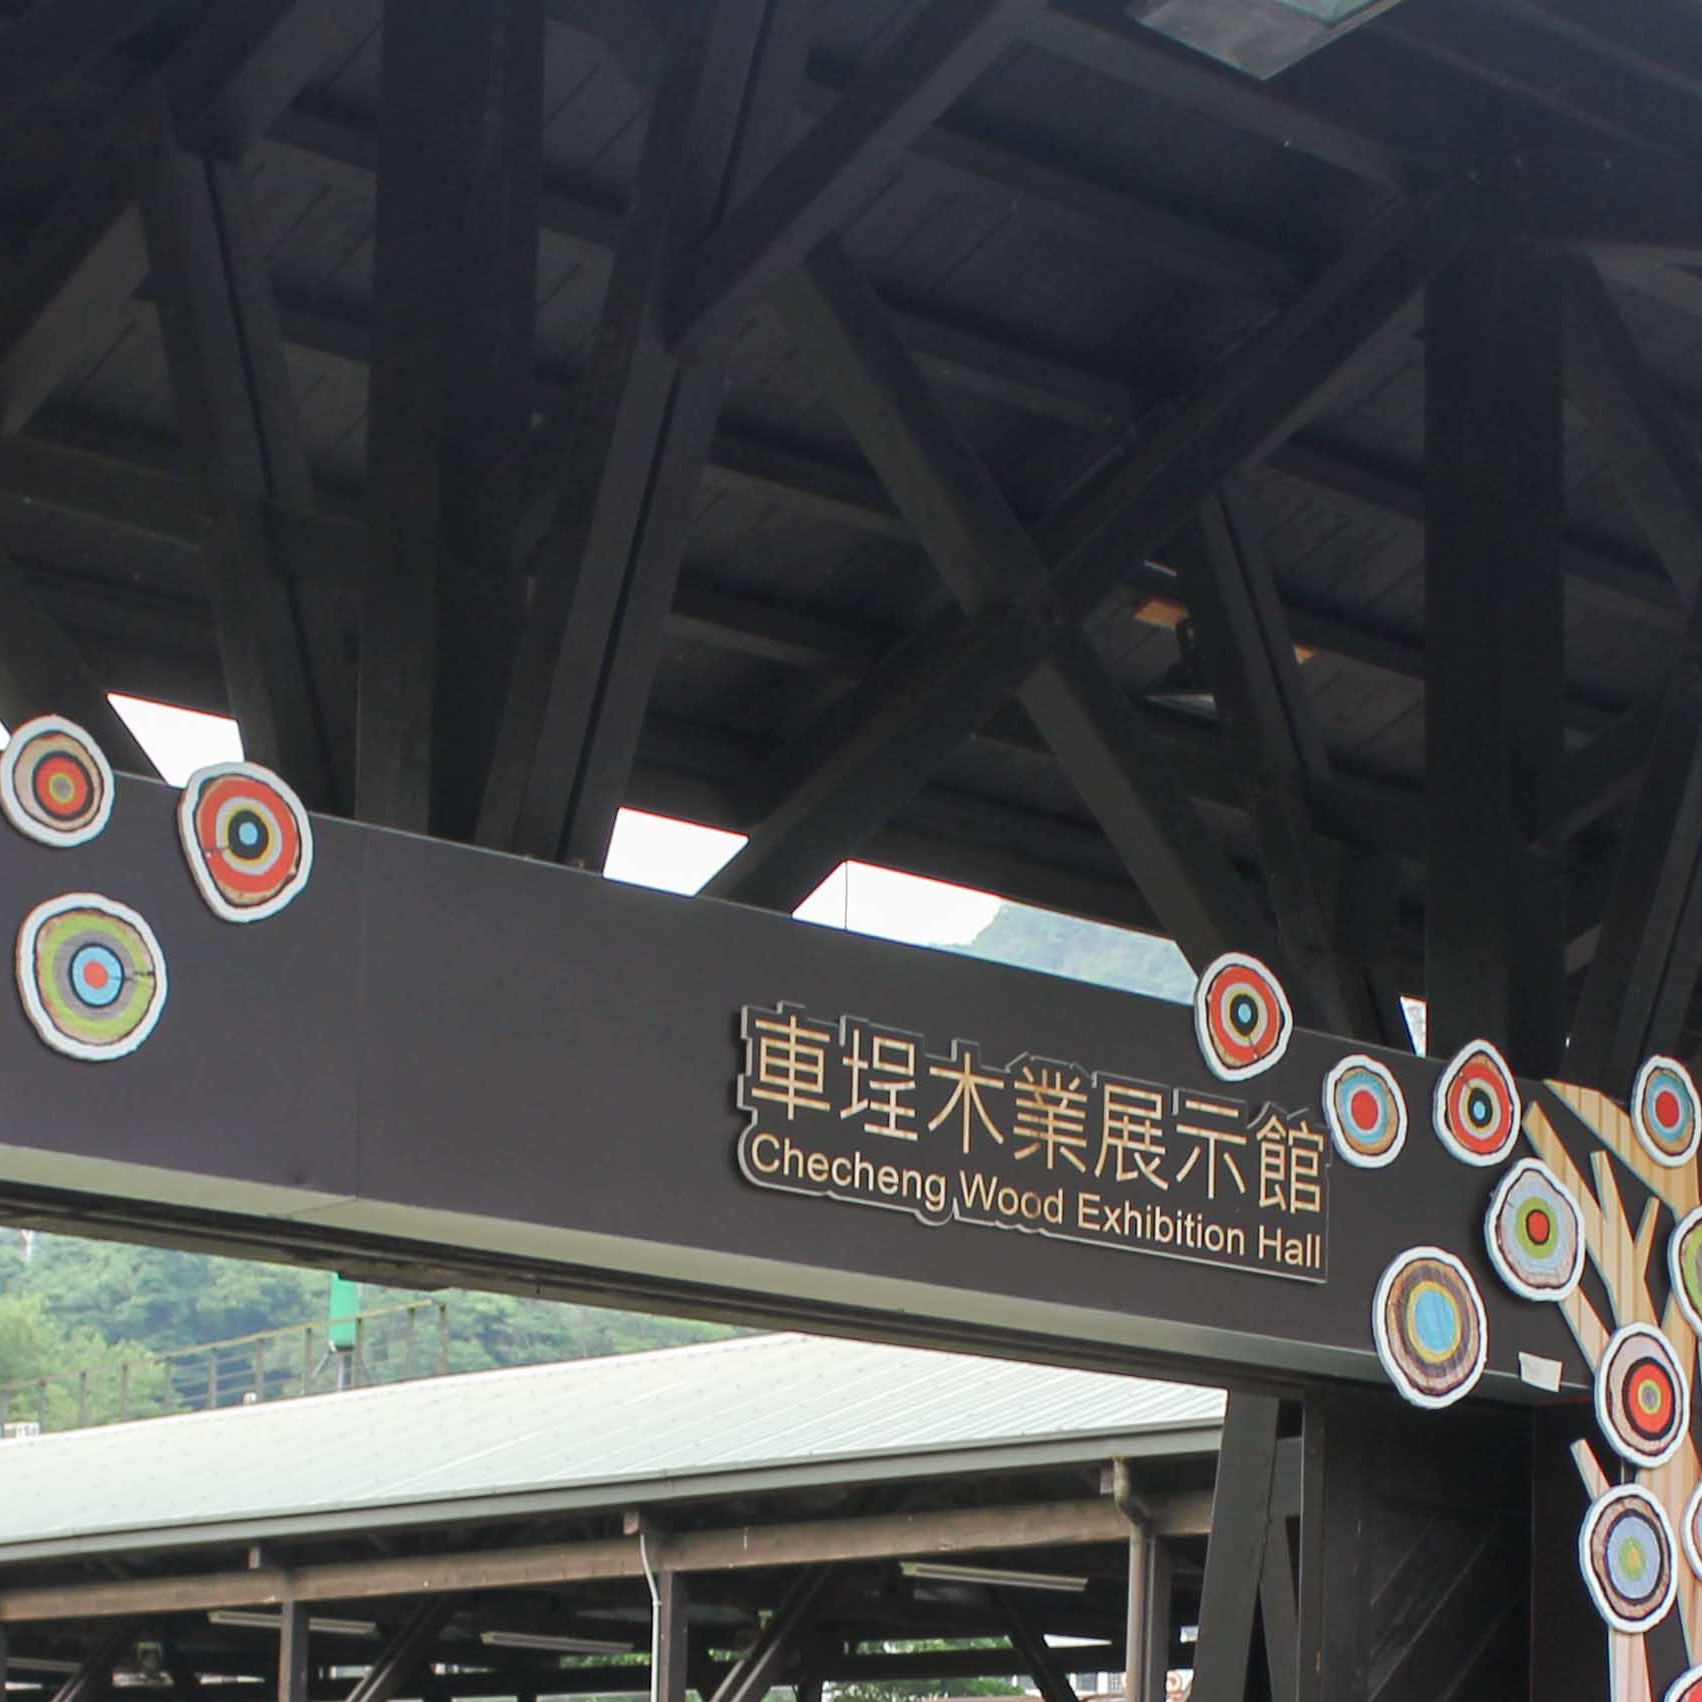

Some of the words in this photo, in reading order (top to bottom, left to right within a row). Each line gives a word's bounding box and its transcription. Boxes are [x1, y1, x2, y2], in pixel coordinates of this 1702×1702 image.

[751, 1014, 1324, 1214] 車埕木業展示館
[751, 1133, 947, 1208] Checheng
[959, 1170, 1064, 1225] Wood
[1077, 1193, 1245, 1256] Exhibition
[1258, 1224, 1321, 1269] Hall
